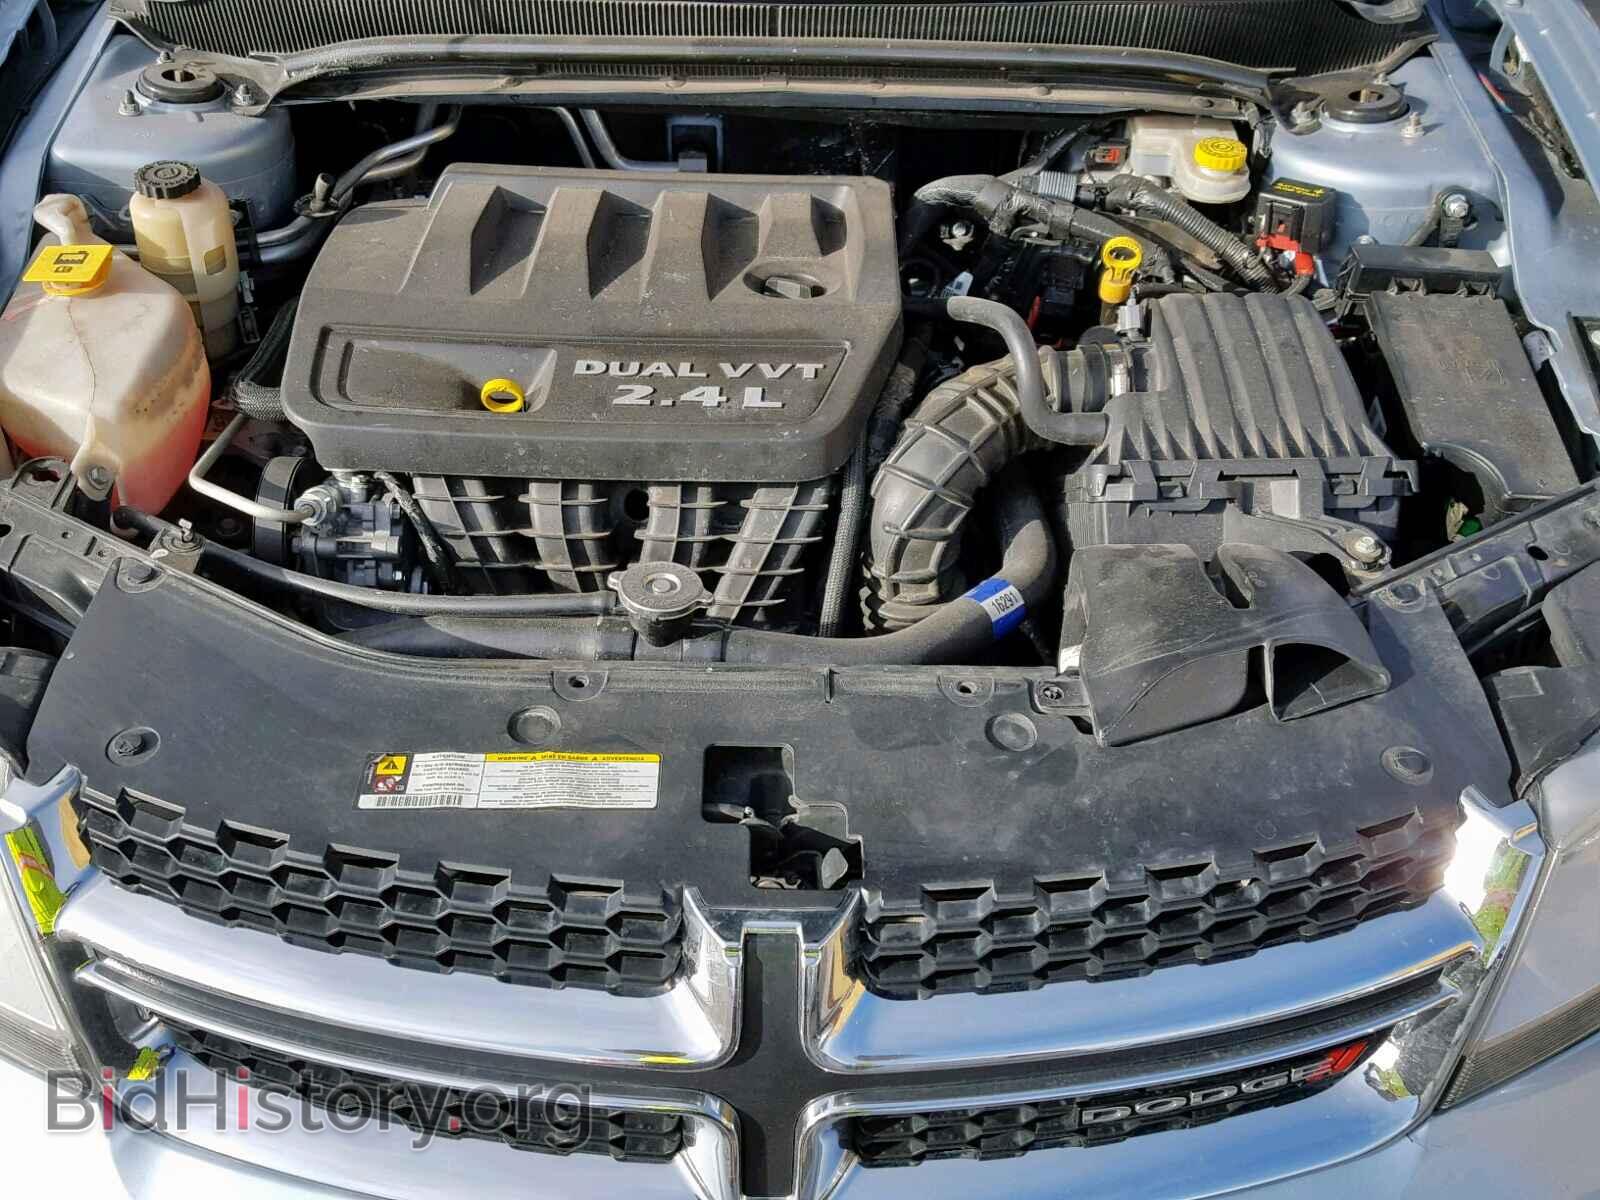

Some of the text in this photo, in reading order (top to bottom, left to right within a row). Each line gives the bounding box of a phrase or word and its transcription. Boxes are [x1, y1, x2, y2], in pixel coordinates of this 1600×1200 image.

[574, 360, 825, 379] DUAL VVT
[1082, 1057, 1333, 1125] DODGE
